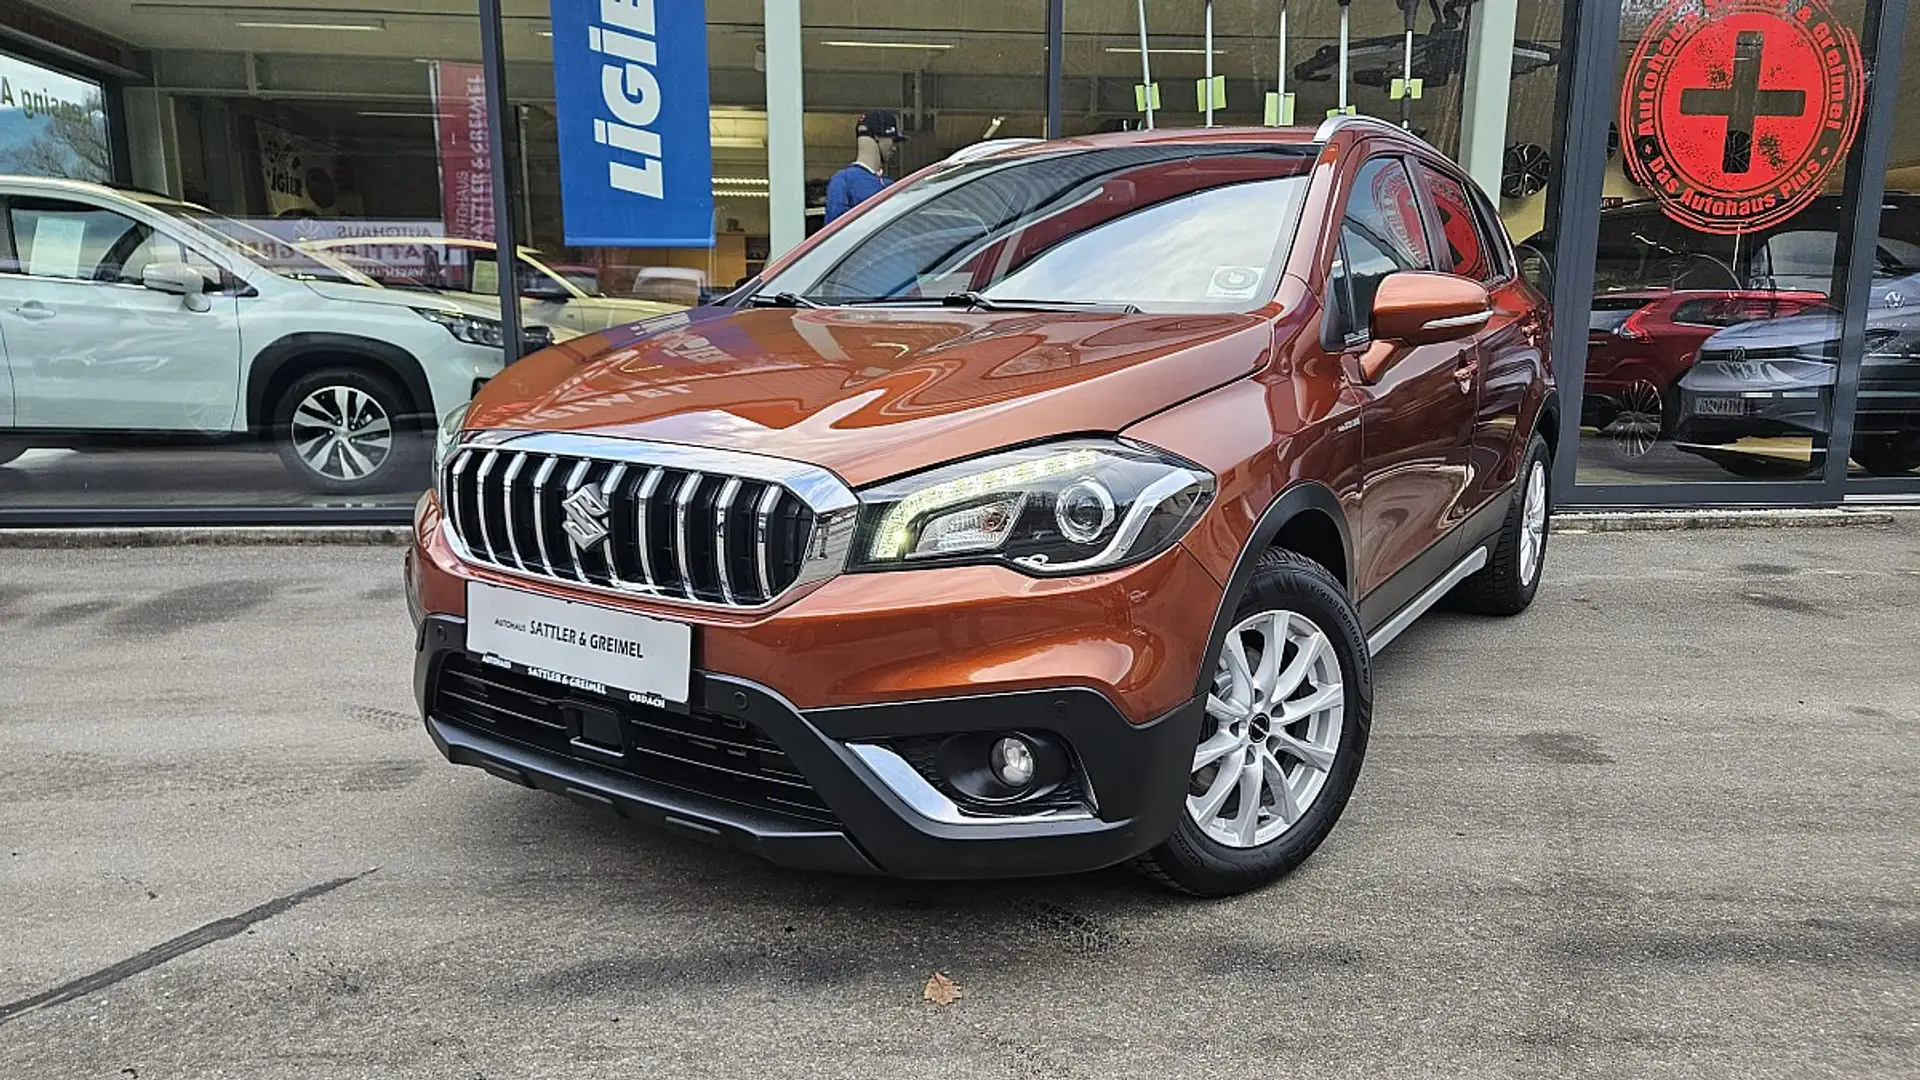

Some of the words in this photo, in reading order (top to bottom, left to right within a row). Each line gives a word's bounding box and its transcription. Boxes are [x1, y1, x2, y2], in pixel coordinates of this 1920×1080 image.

[1812, 21, 1847, 130] Greimel
[470, 173, 485, 242] ATTLER
[1649, 156, 1680, 194] Das
[1679, 187, 1776, 216] Autohaus
[1779, 158, 1821, 200] Plus
[494, 616, 526, 632] AUTOHAUS
[530, 620, 576, 644] SATTLER
[579, 632, 587, 646] &
[590, 633, 644, 659] GREIMEL
[527, 666, 561, 683] SATTLER
[569, 677, 607, 695] GREIMEL
